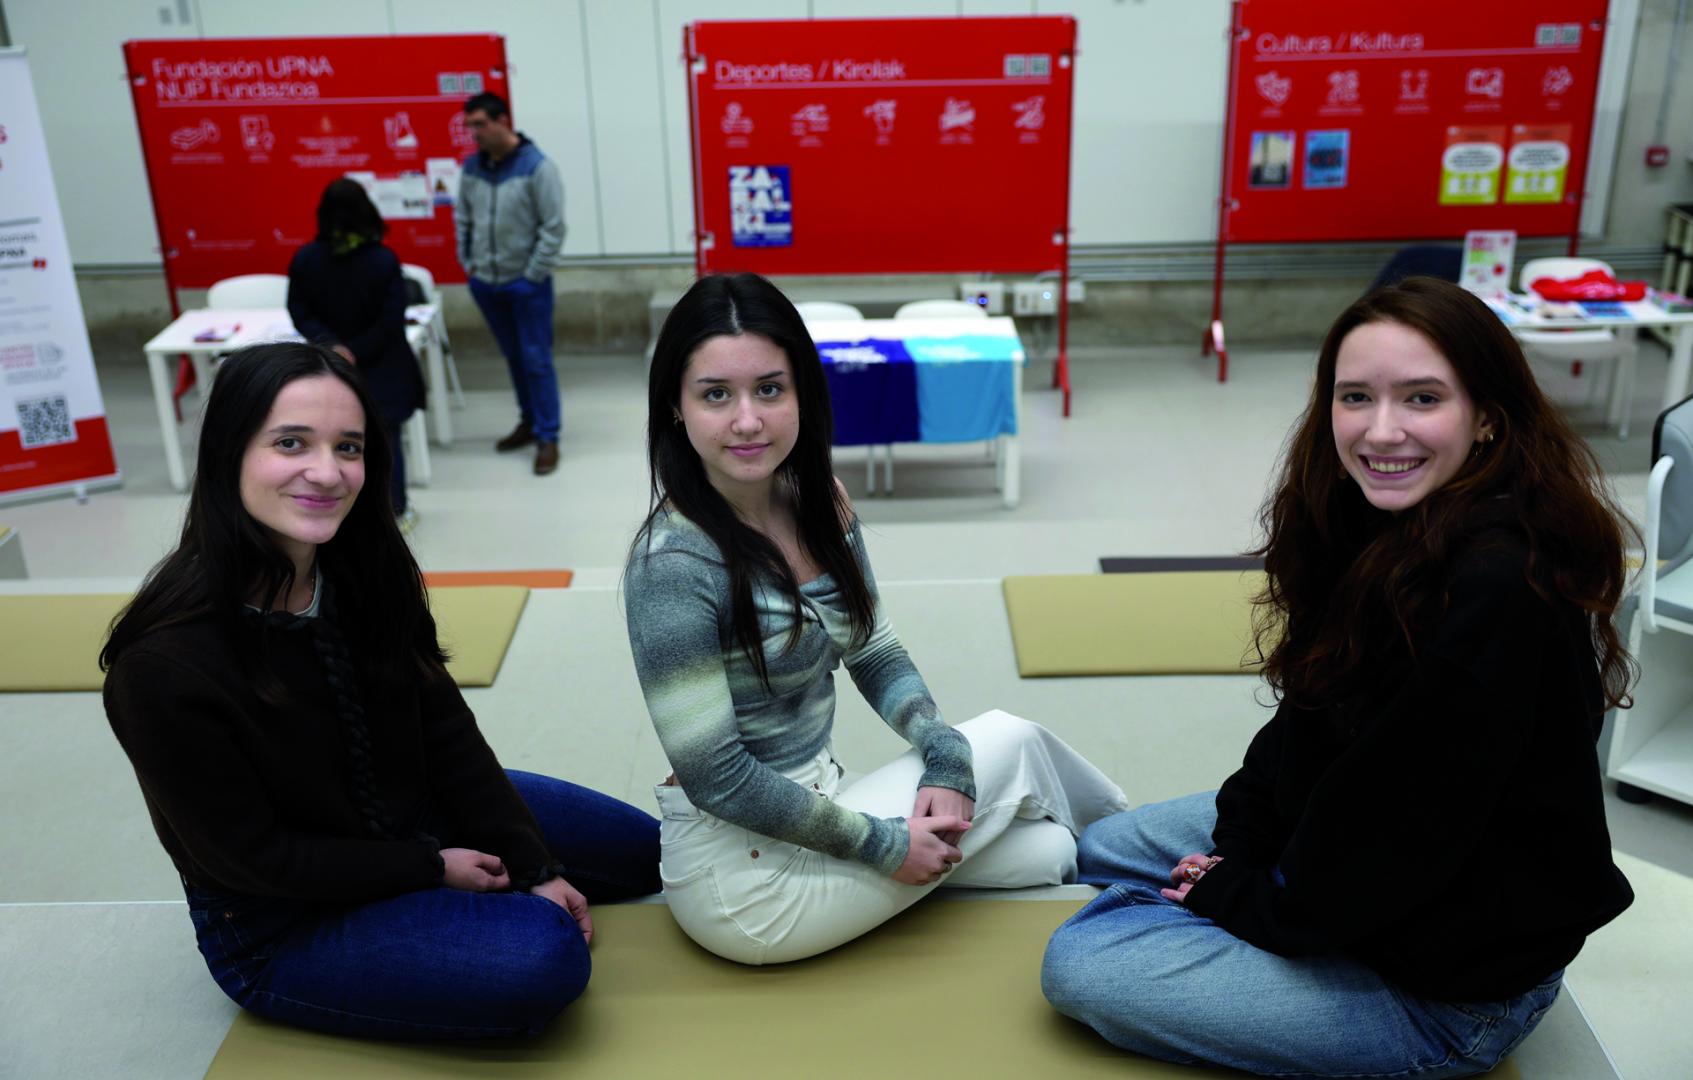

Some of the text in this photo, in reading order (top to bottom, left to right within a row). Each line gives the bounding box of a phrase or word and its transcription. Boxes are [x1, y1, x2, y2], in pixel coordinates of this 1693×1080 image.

[1256, 32, 1332, 53] Cultura
[1350, 31, 1424, 51] Kultura
[266, 55, 334, 78] UPNA
[714, 58, 906, 86] Deportes / Kirolak
[156, 79, 206, 99] NUP
